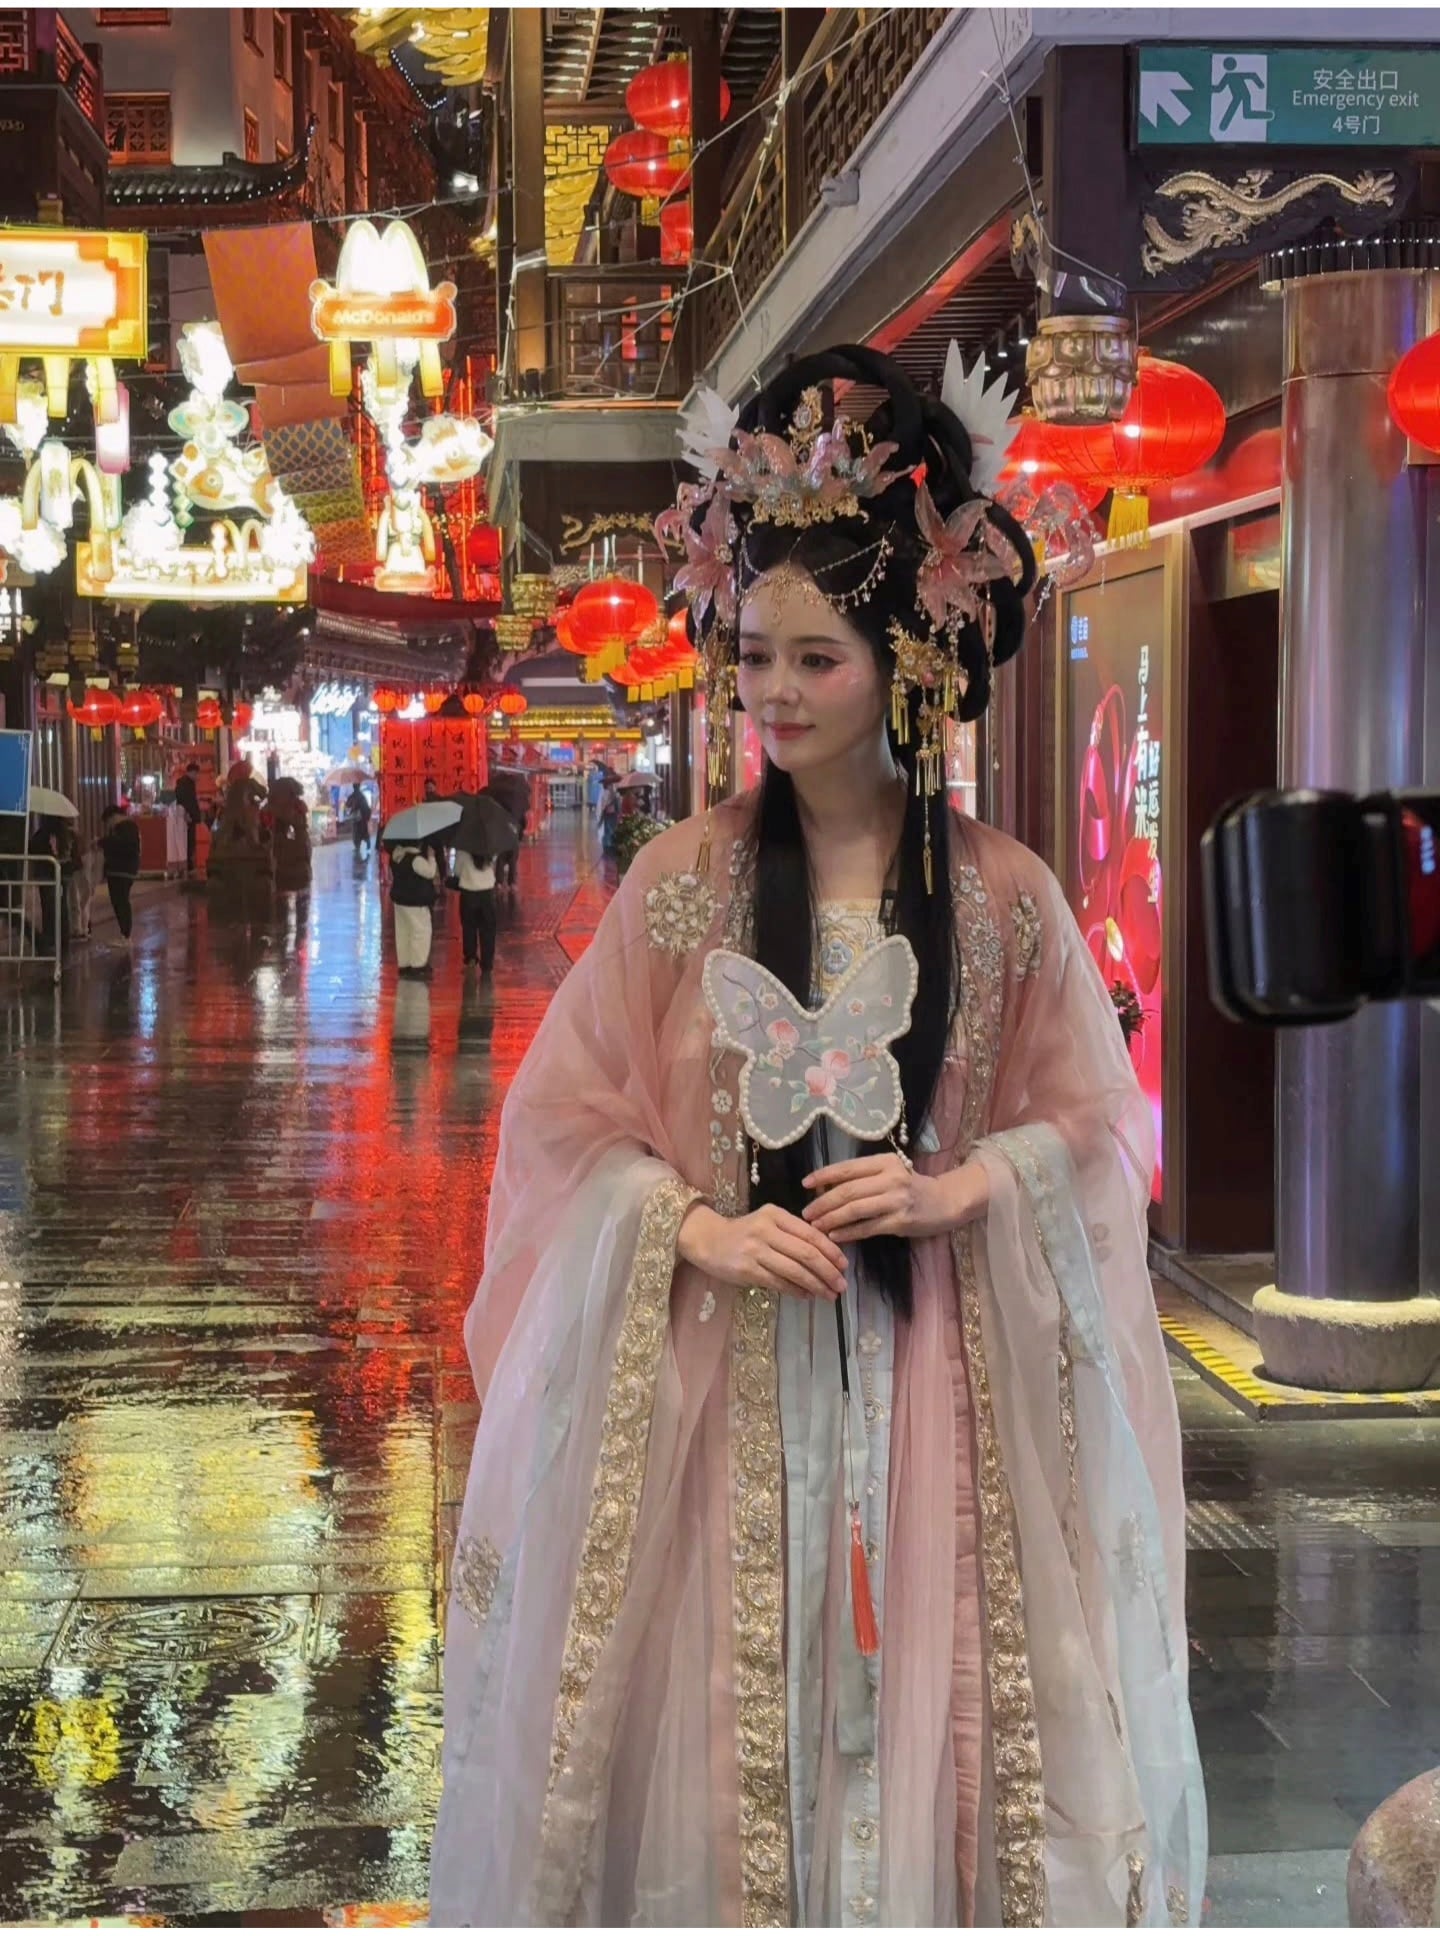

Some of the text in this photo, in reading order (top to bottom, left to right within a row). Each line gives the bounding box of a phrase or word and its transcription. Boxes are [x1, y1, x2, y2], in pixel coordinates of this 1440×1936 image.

[1312, 67, 1399, 91] 安全出口
[1292, 89, 1420, 111] Emergency exit
[1332, 115, 1381, 135] 4号门
